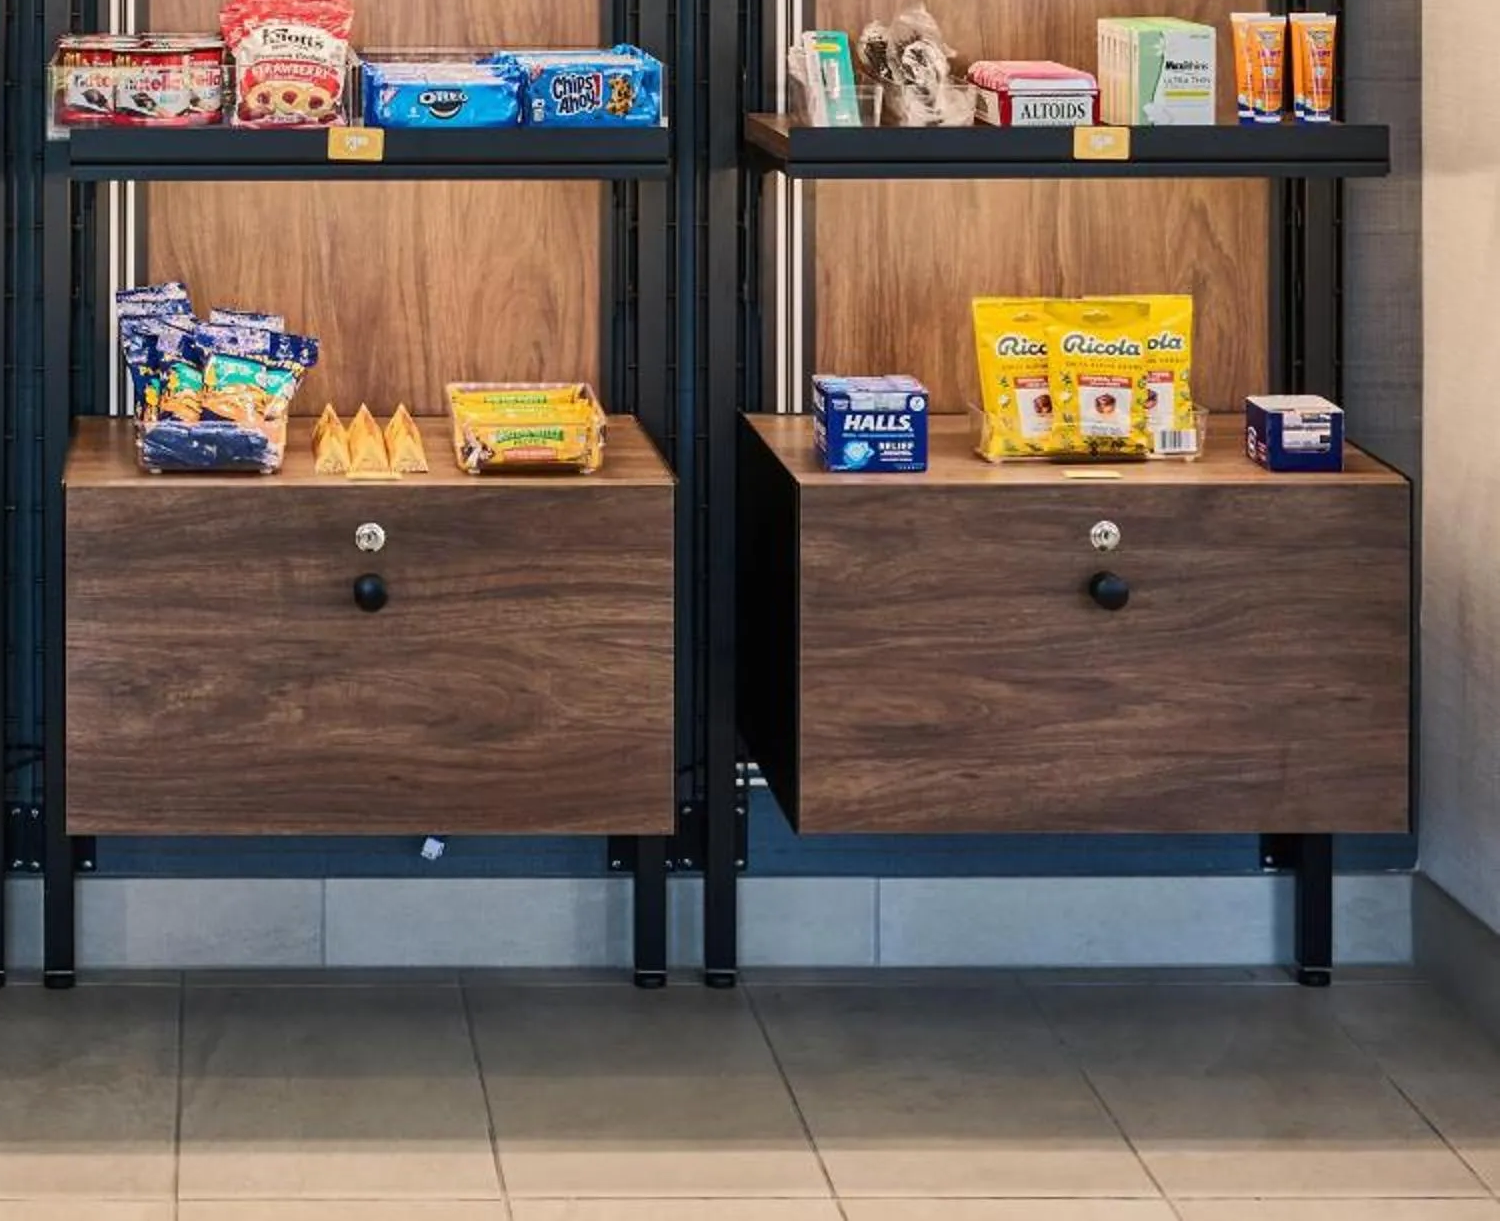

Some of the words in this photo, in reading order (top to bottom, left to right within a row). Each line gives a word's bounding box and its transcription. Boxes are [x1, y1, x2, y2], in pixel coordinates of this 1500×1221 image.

[552, 74, 593, 99] Chips
[1021, 103, 1087, 120] ALTOIDS
[1063, 334, 1141, 356] Ricola
[843, 415, 911, 431] HALLS
